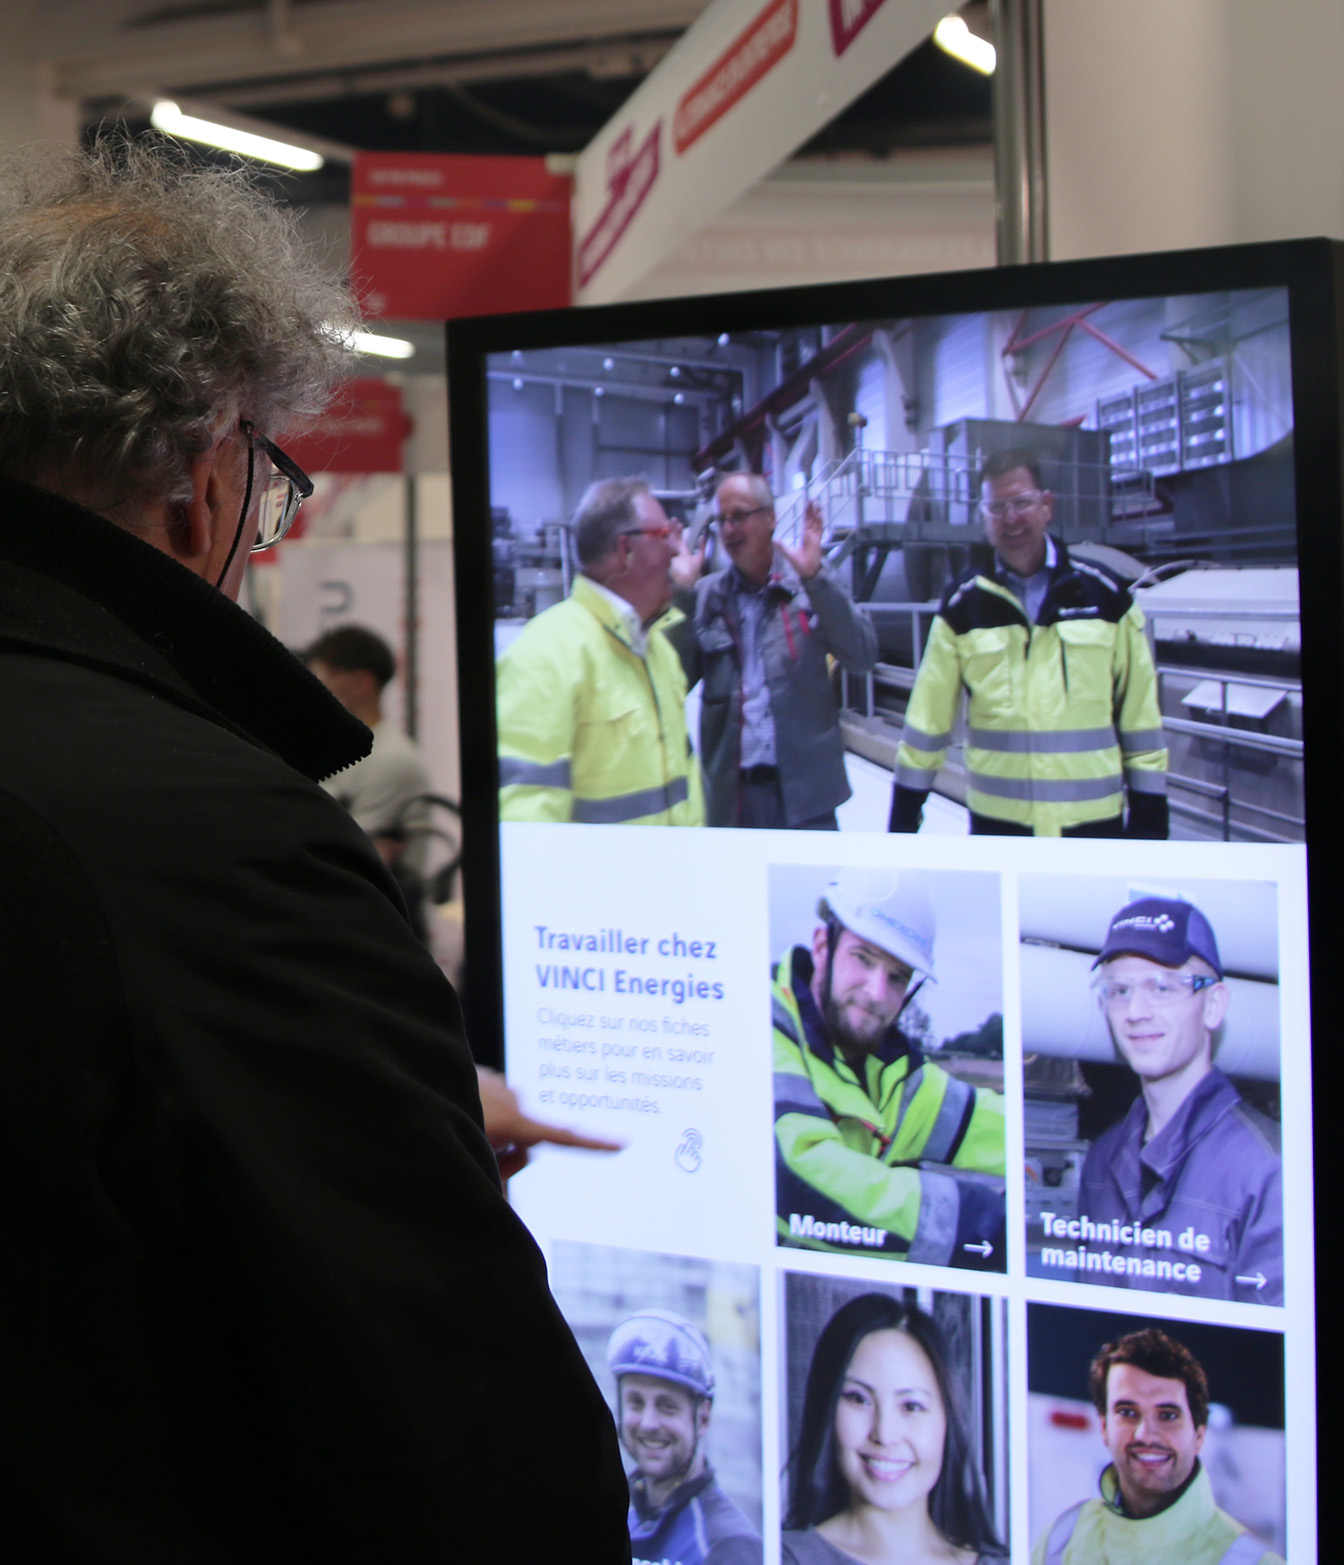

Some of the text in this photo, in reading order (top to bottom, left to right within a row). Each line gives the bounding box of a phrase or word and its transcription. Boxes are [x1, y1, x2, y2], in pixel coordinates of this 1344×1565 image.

[535, 926, 718, 959] Travailler chez
[535, 964, 725, 1004] VINCI Energies
[537, 1007, 710, 1036] Cliquez sur nos fiches
[538, 1035, 716, 1064] métiers pour en savoir
[539, 1061, 703, 1090] plus sur les missions
[539, 1089, 663, 1114] et opportunités.
[789, 1213, 888, 1247] Monteur
[1040, 1212, 1211, 1251] Technicien de
[1041, 1245, 1202, 1283] maintenance
